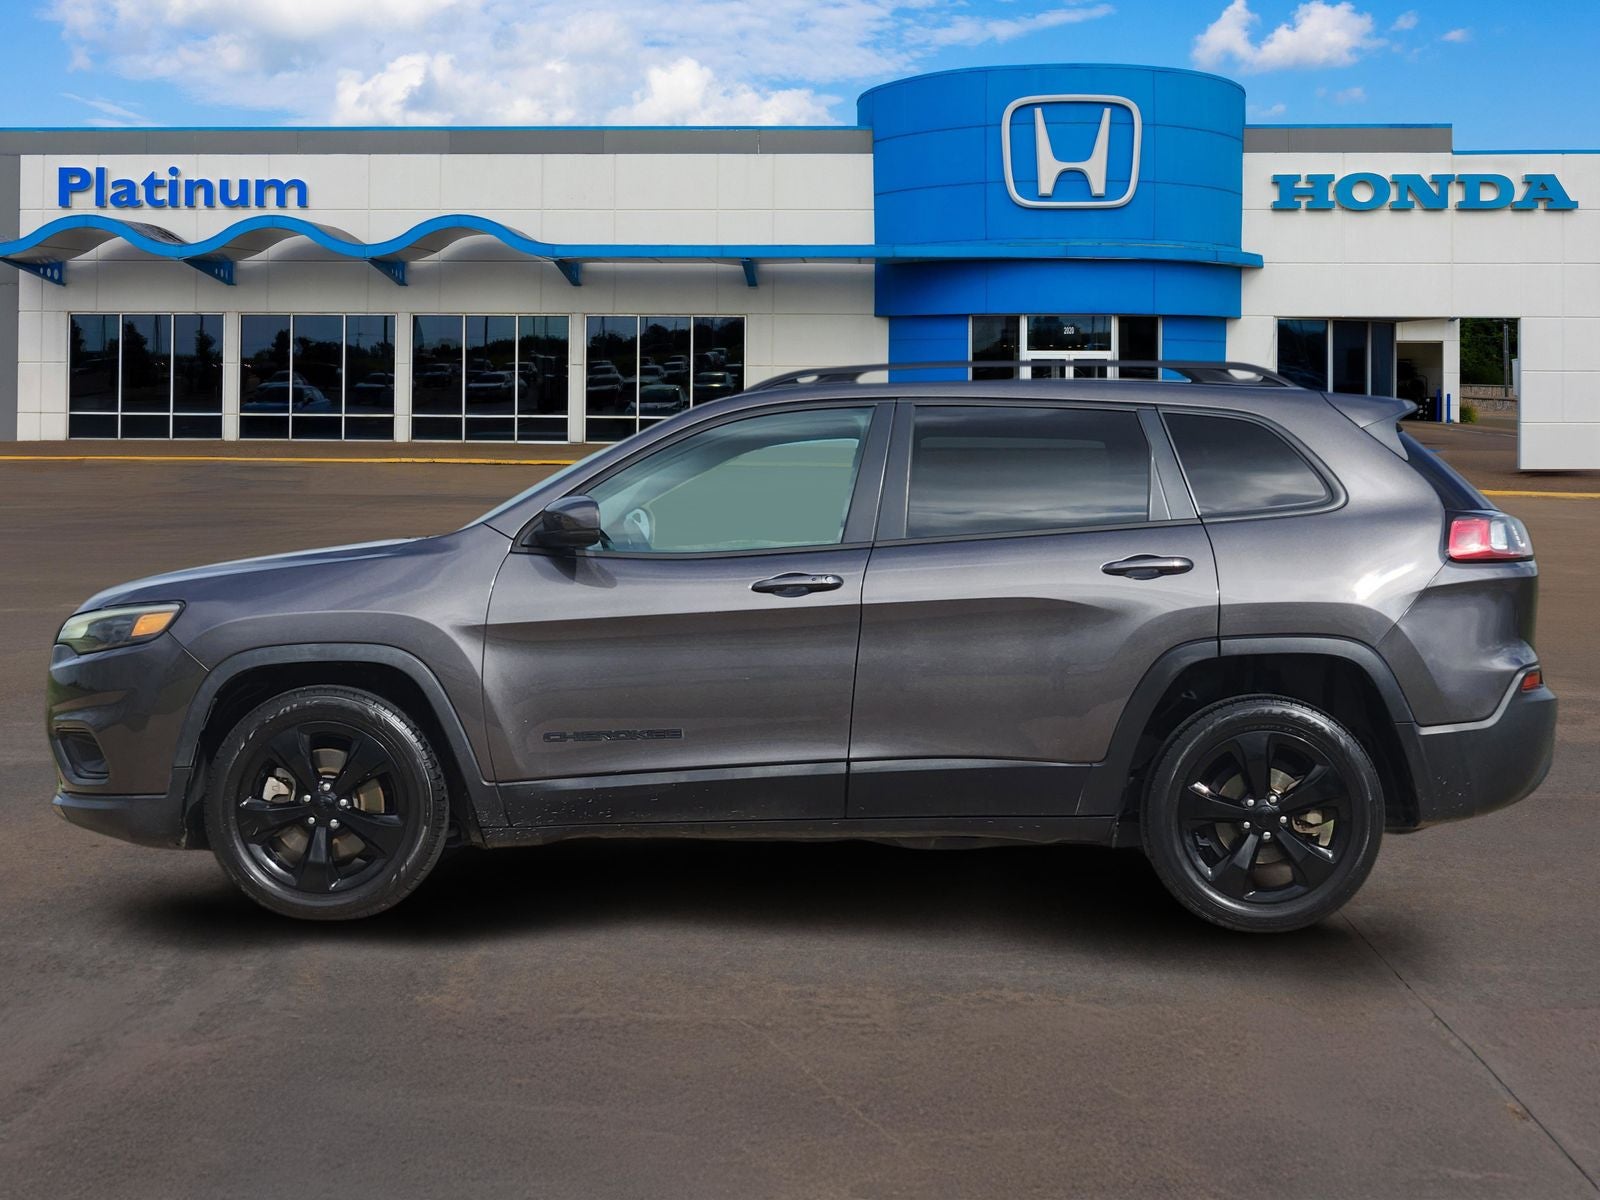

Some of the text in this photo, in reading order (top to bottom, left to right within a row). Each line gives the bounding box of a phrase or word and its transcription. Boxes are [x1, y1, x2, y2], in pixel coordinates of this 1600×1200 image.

[58, 166, 308, 208] Platinum
[1271, 172, 1578, 211] HONDA
[543, 728, 684, 743] CHEROKEE
